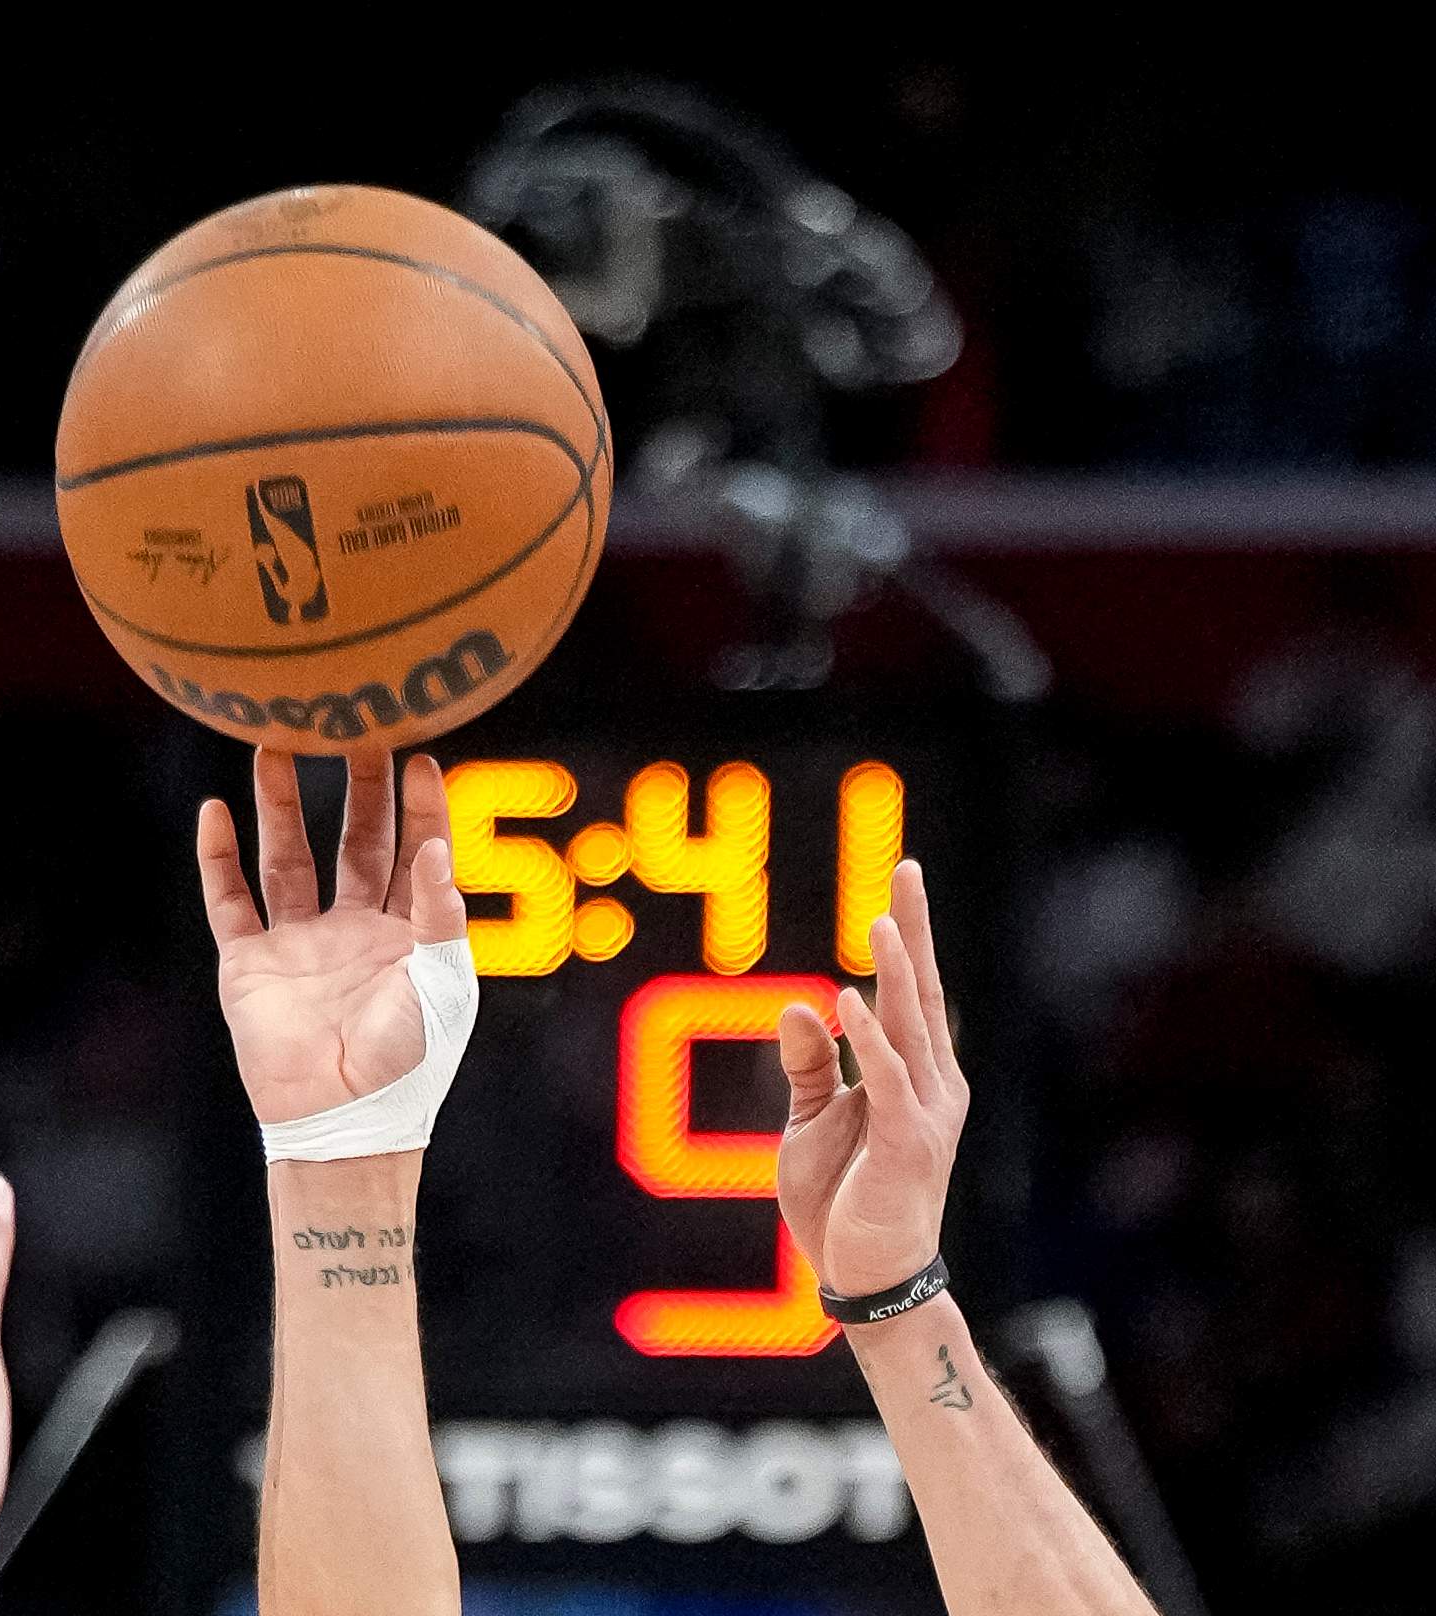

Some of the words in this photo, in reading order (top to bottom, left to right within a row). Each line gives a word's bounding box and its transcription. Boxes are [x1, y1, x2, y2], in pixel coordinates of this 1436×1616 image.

[443, 760, 905, 976] 5:41
[869, 1296, 914, 1321] ACTIVE
[437, 1420, 911, 1545] TISSOT
